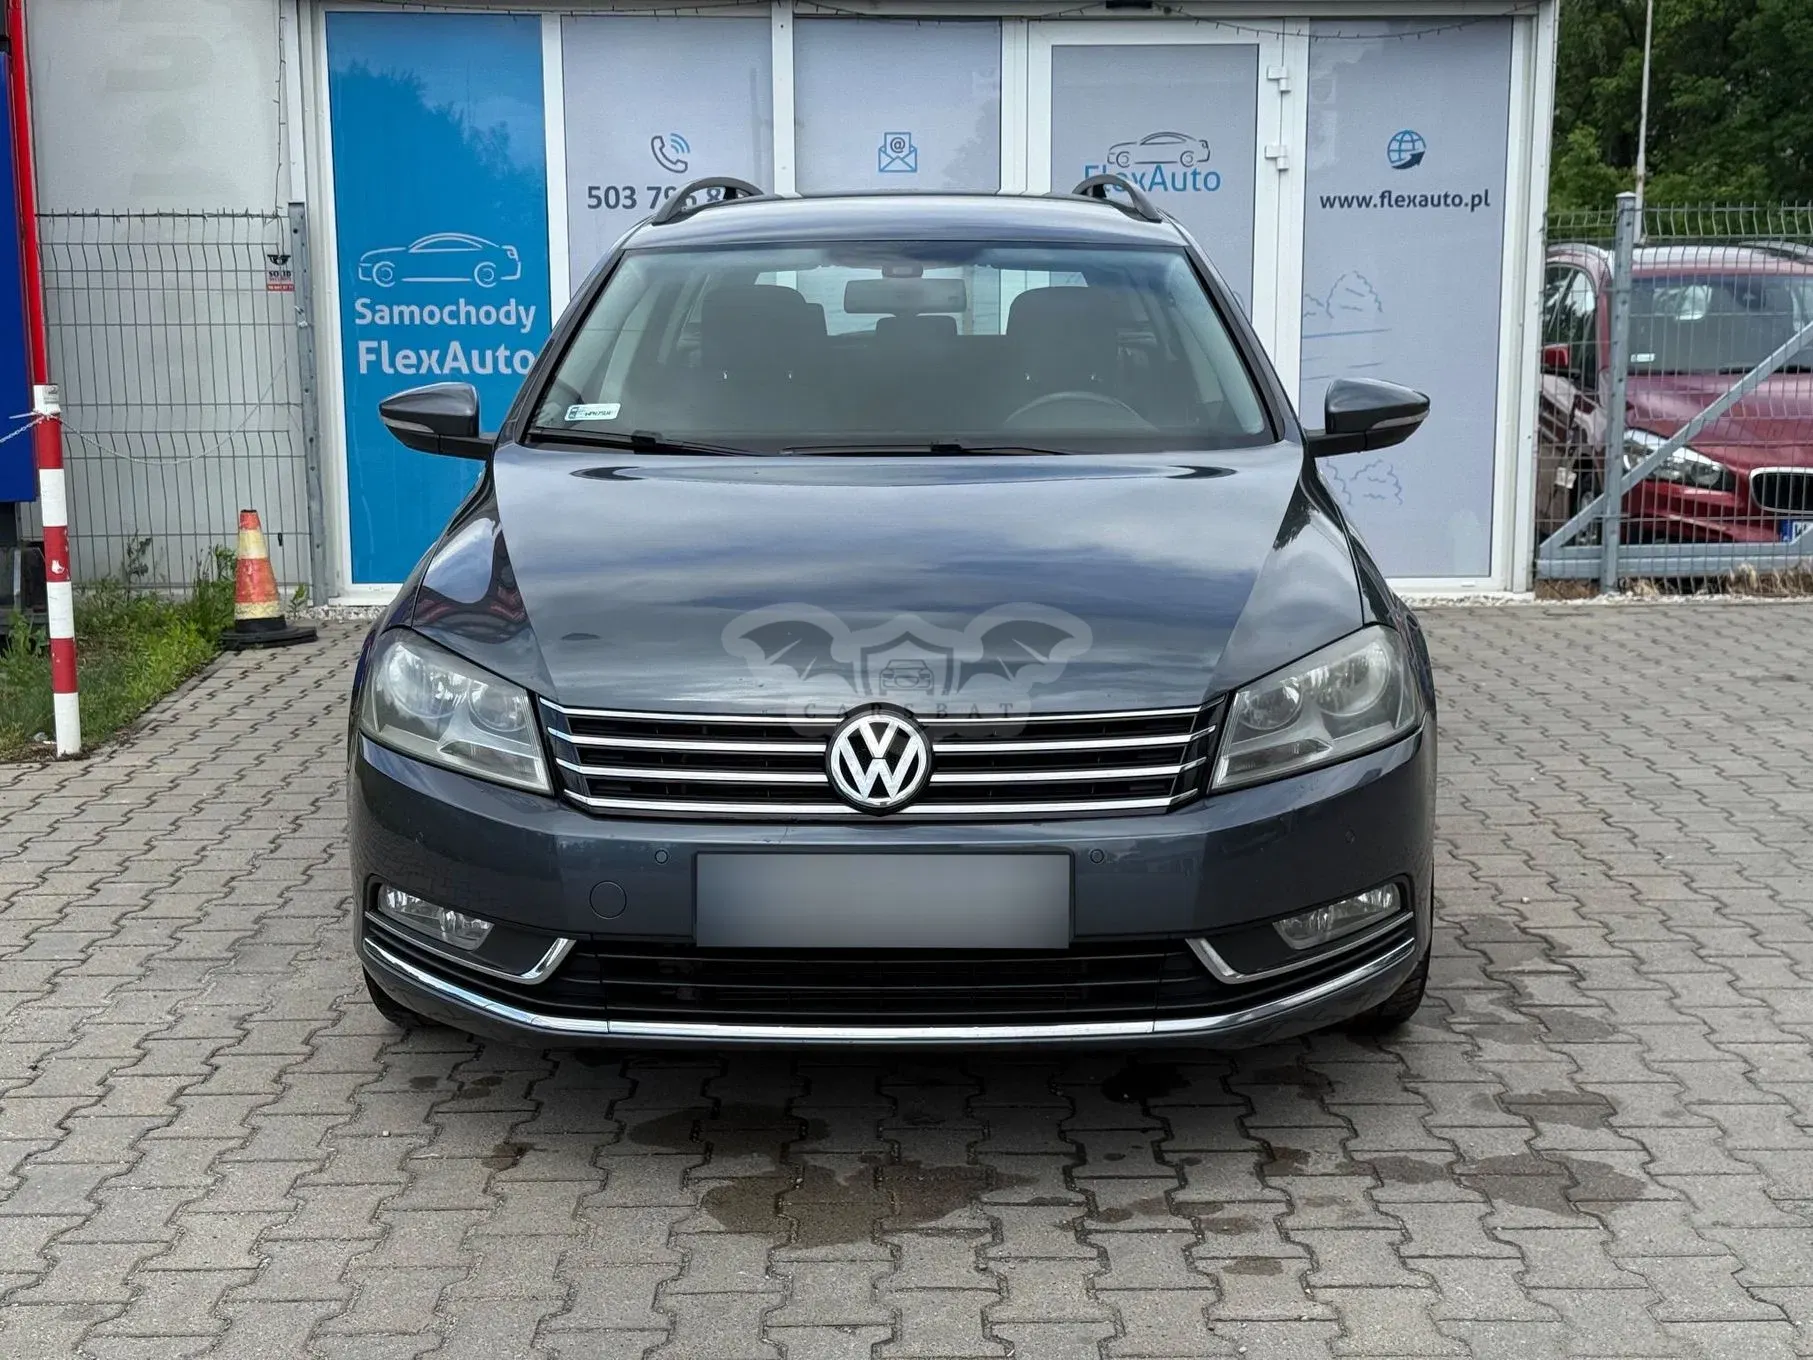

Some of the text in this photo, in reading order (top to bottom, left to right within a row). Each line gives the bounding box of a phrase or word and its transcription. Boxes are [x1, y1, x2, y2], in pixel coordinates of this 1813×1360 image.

[587, 185, 637, 210] 503
[1319, 189, 1491, 213] www.flexauto.pl
[354, 298, 536, 333] Samochody
[357, 340, 535, 374] FlexAuto
